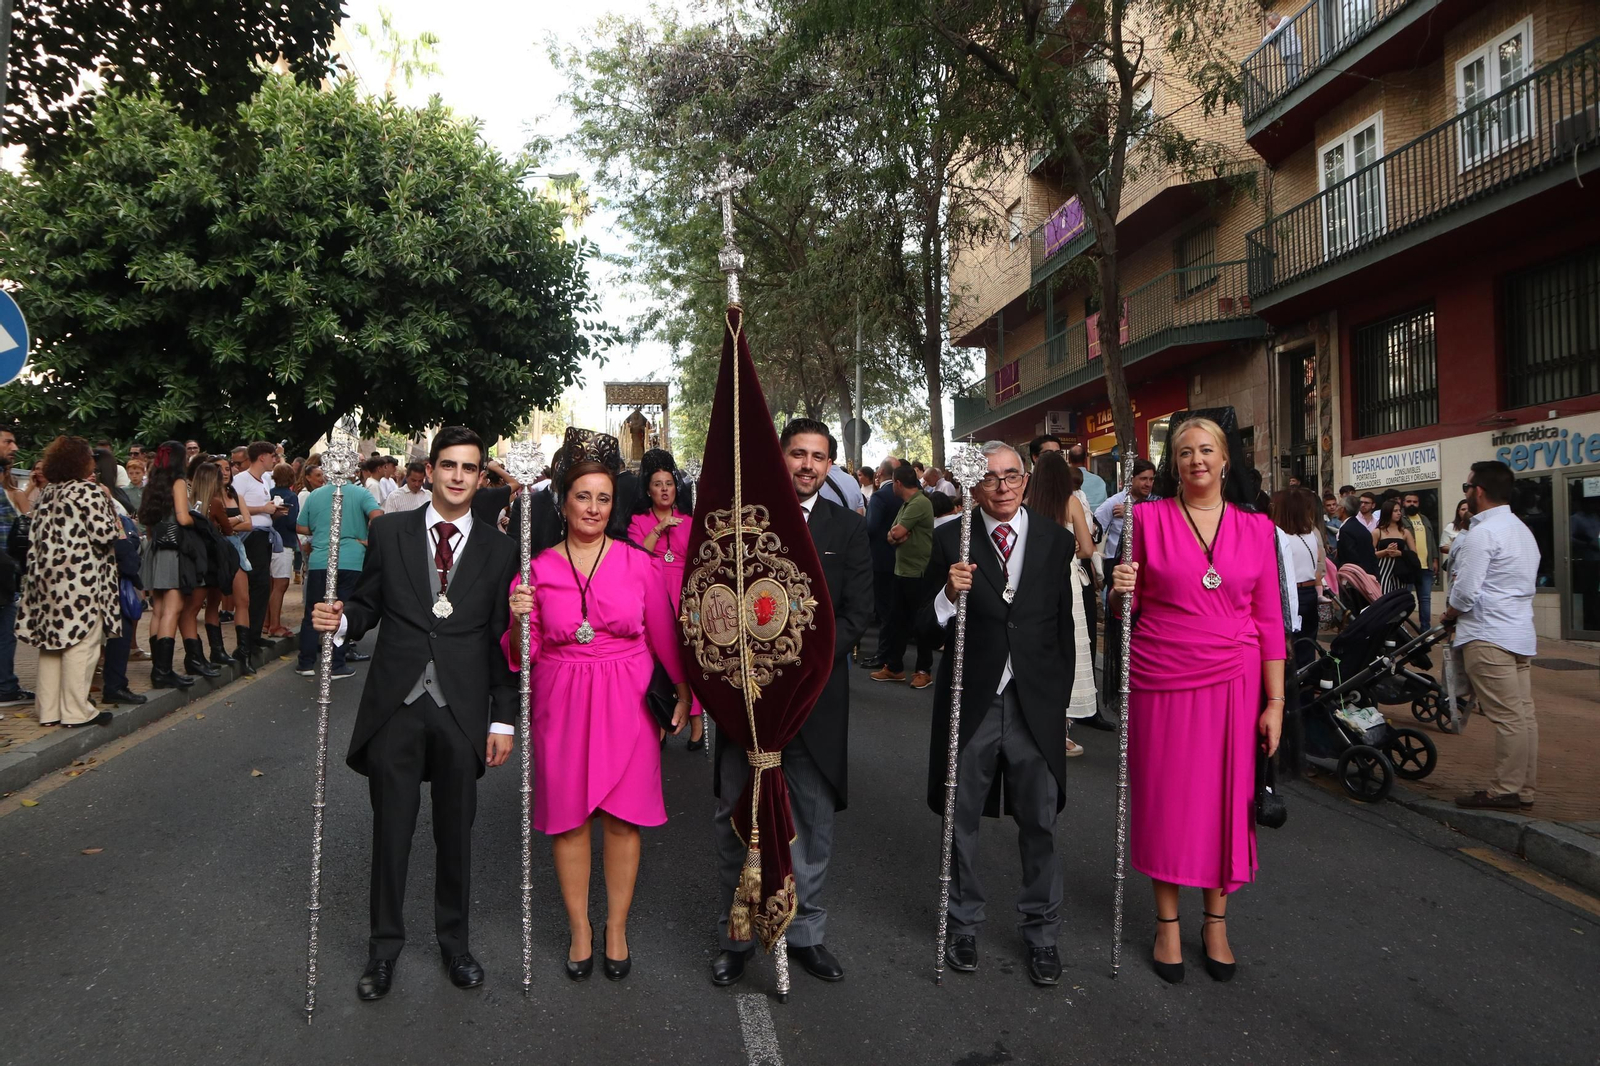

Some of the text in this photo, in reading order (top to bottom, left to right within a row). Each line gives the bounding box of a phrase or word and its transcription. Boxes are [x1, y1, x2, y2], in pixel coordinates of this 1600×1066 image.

[1096, 399, 1136, 424] TABS
[1492, 425, 1559, 447] informática
[1352, 447, 1437, 475] REPARACION Y VENTA
[1356, 471, 1377, 481] PORTATILES
[1386, 474, 1410, 485] COMPATIBLES
[1413, 471, 1436, 481] ORIGINALES
[1394, 466, 1421, 476] CONSUMIBLES
[1353, 479, 1382, 489] ORDENADORES
